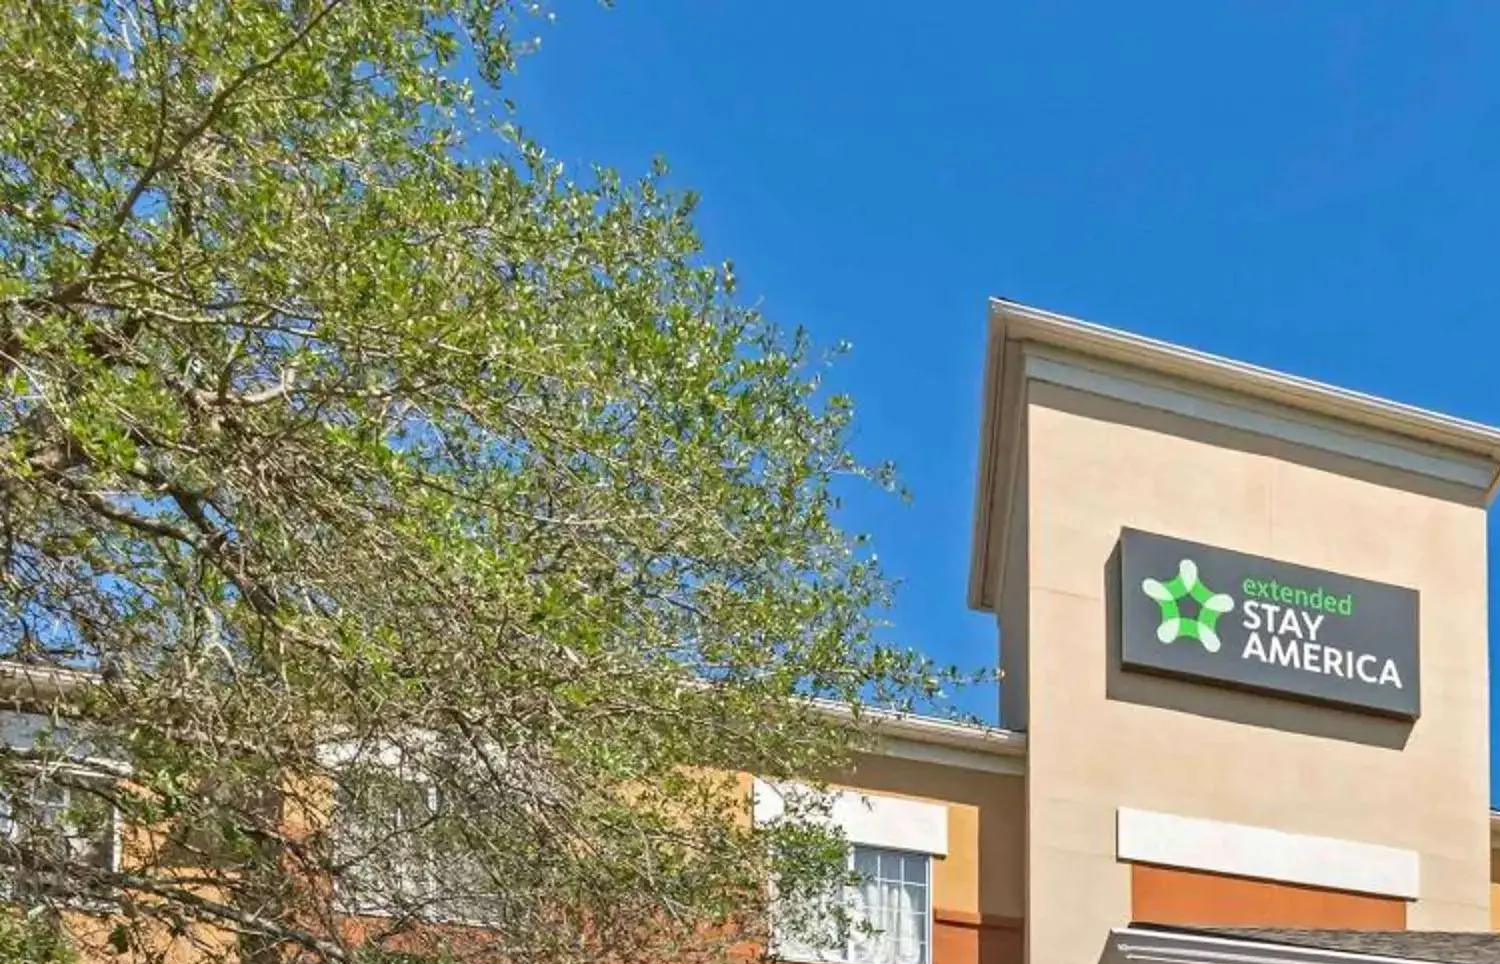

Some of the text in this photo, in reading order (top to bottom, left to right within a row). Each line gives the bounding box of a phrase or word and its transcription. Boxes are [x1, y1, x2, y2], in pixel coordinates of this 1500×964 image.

[1242, 577, 1352, 616] extended
[1242, 600, 1325, 642] STAY
[1241, 632, 1404, 689] AMERICA
